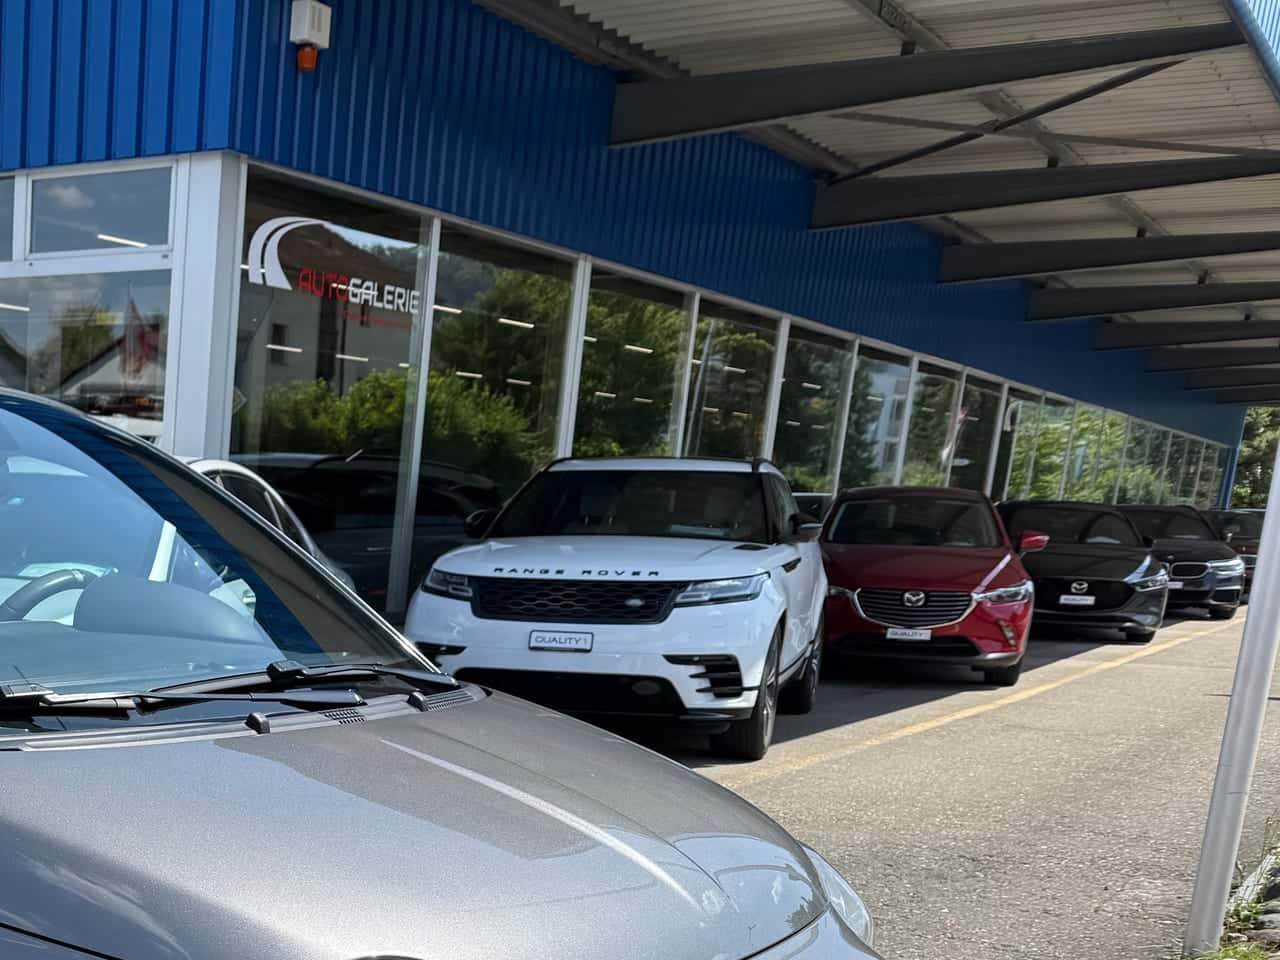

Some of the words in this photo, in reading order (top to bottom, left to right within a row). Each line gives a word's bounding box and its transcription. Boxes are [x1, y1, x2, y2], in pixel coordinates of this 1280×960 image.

[297, 267, 420, 315] AUTOGALERIE
[494, 567, 566, 575] RANGE
[581, 569, 660, 577] ROVER
[535, 635, 582, 645] QUALITY
